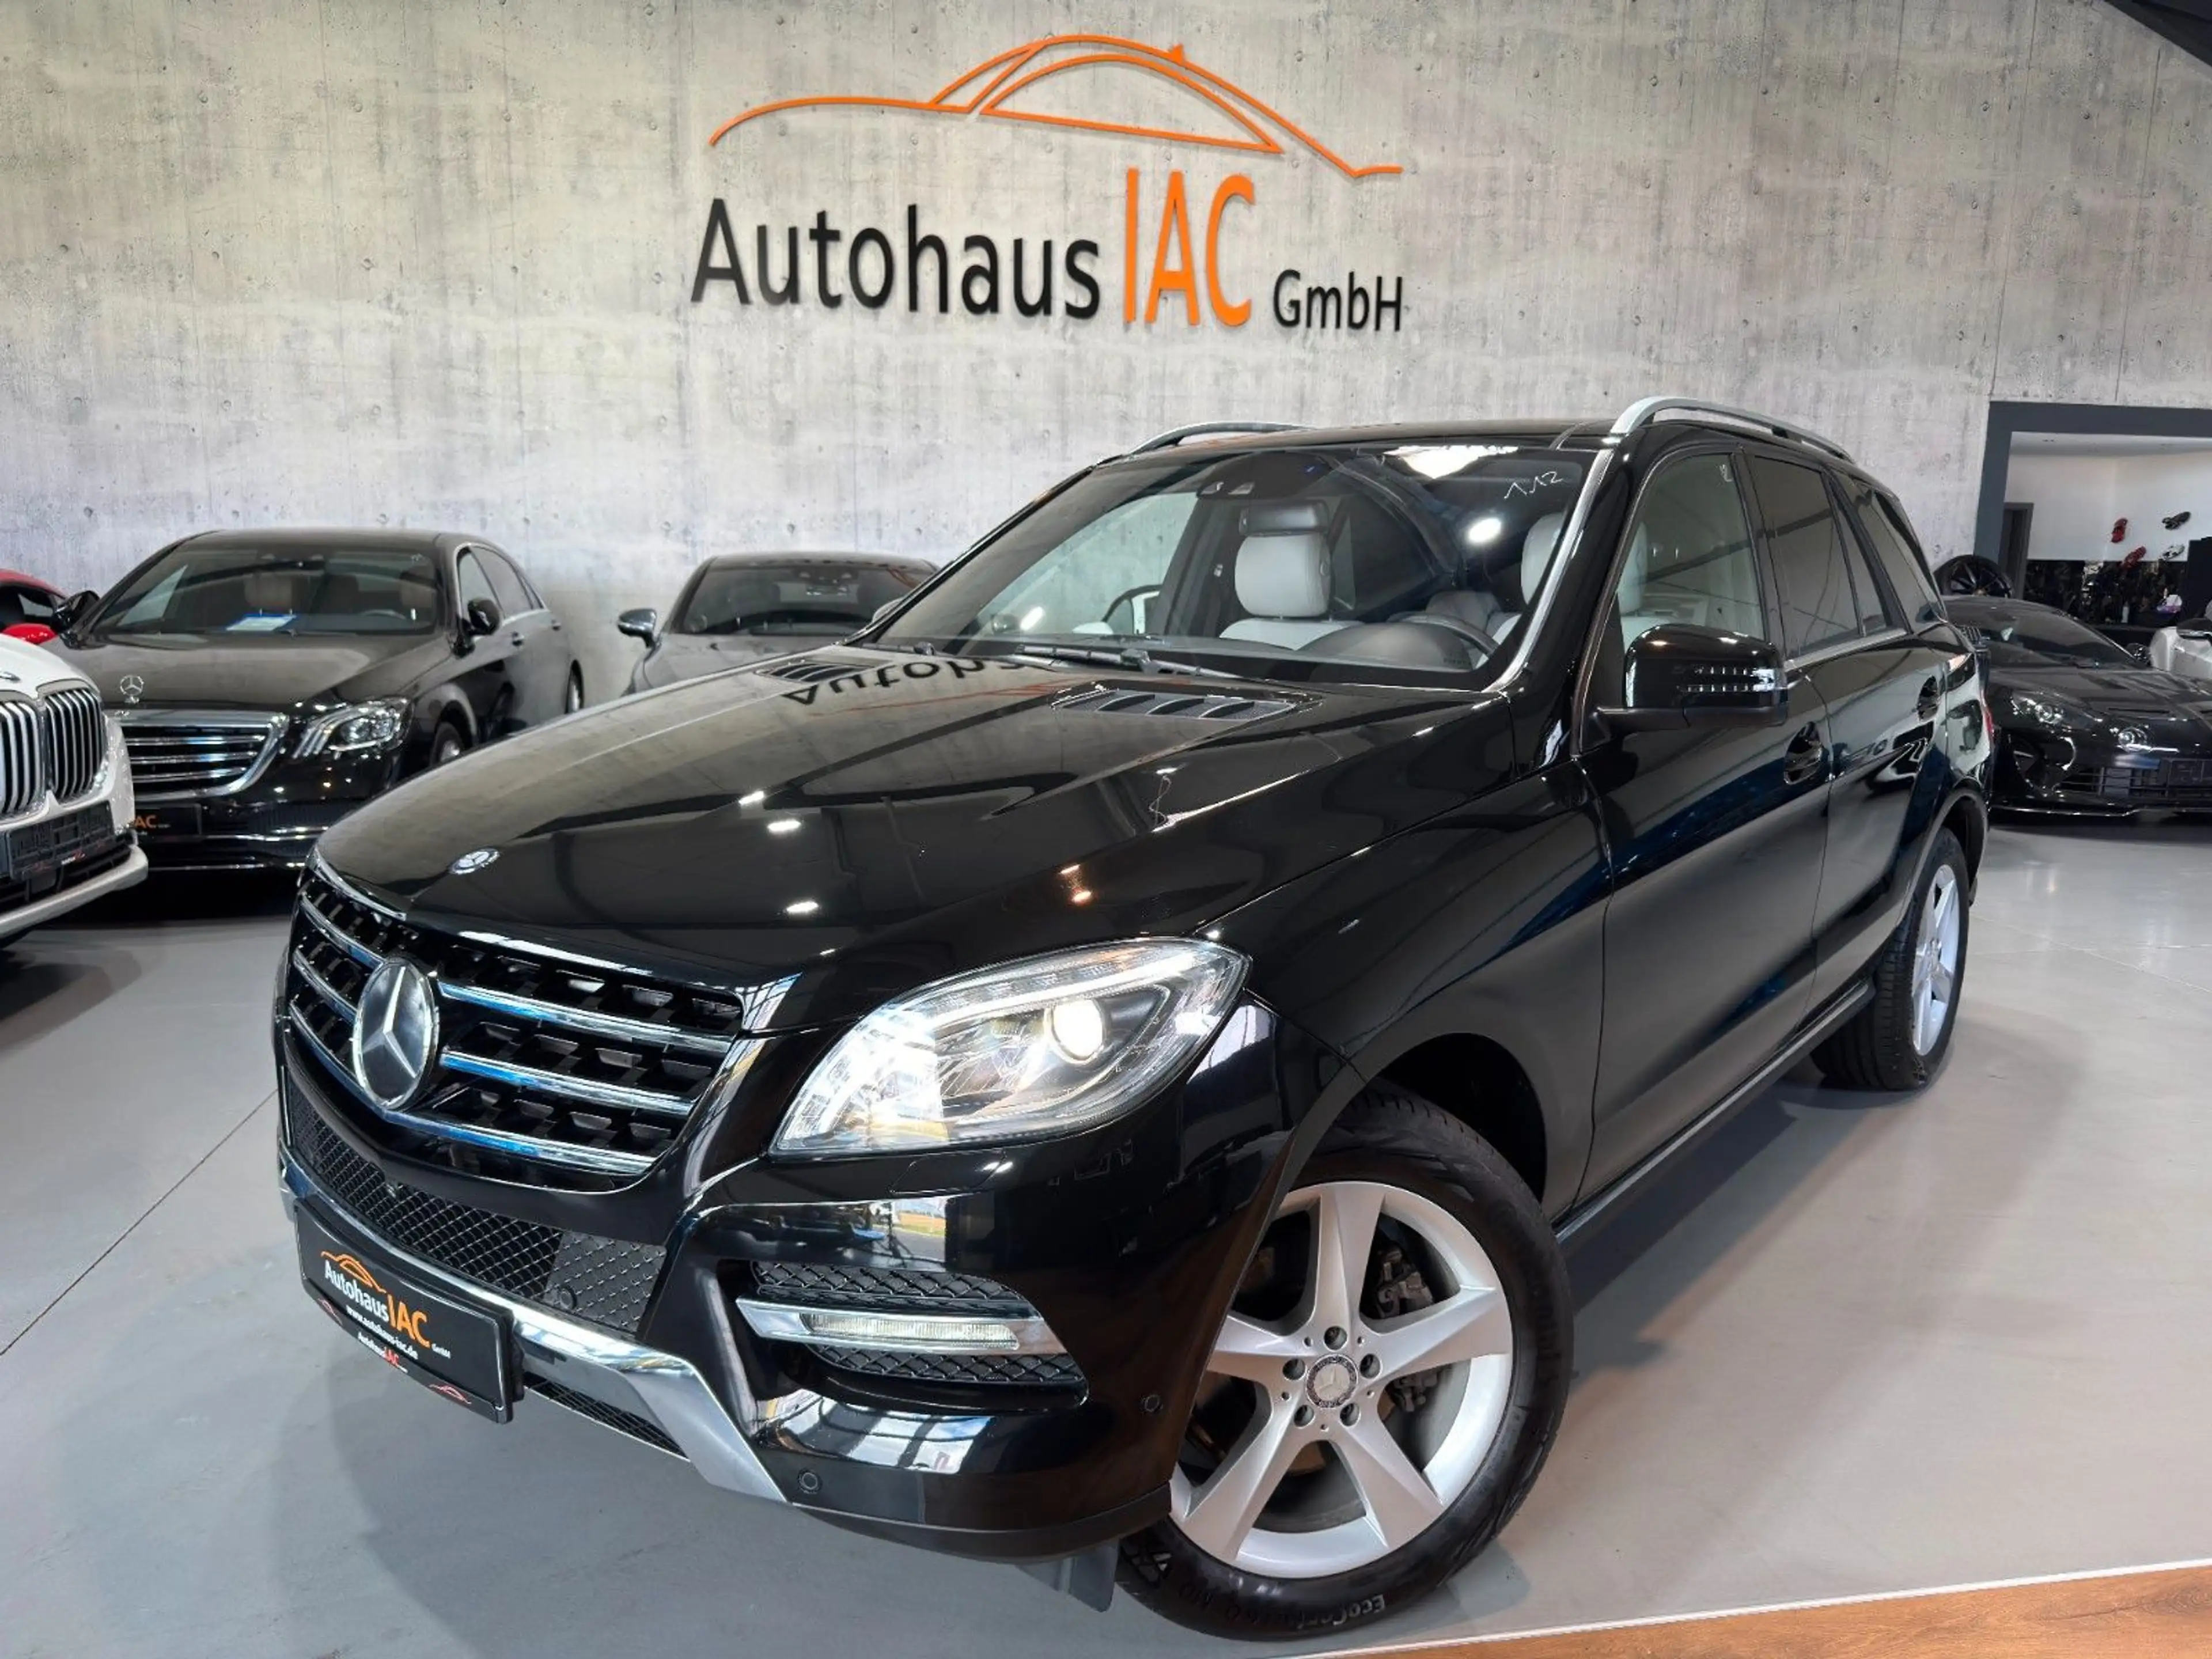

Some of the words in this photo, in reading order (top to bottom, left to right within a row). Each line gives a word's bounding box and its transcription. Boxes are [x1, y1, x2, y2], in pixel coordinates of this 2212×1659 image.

[691, 198, 1100, 320] Autohaus
[1124, 168, 1256, 327] IAC
[1272, 269, 1403, 332] GmbH
[324, 1260, 389, 1322] Autohaus
[387, 1293, 431, 1349] IAC
